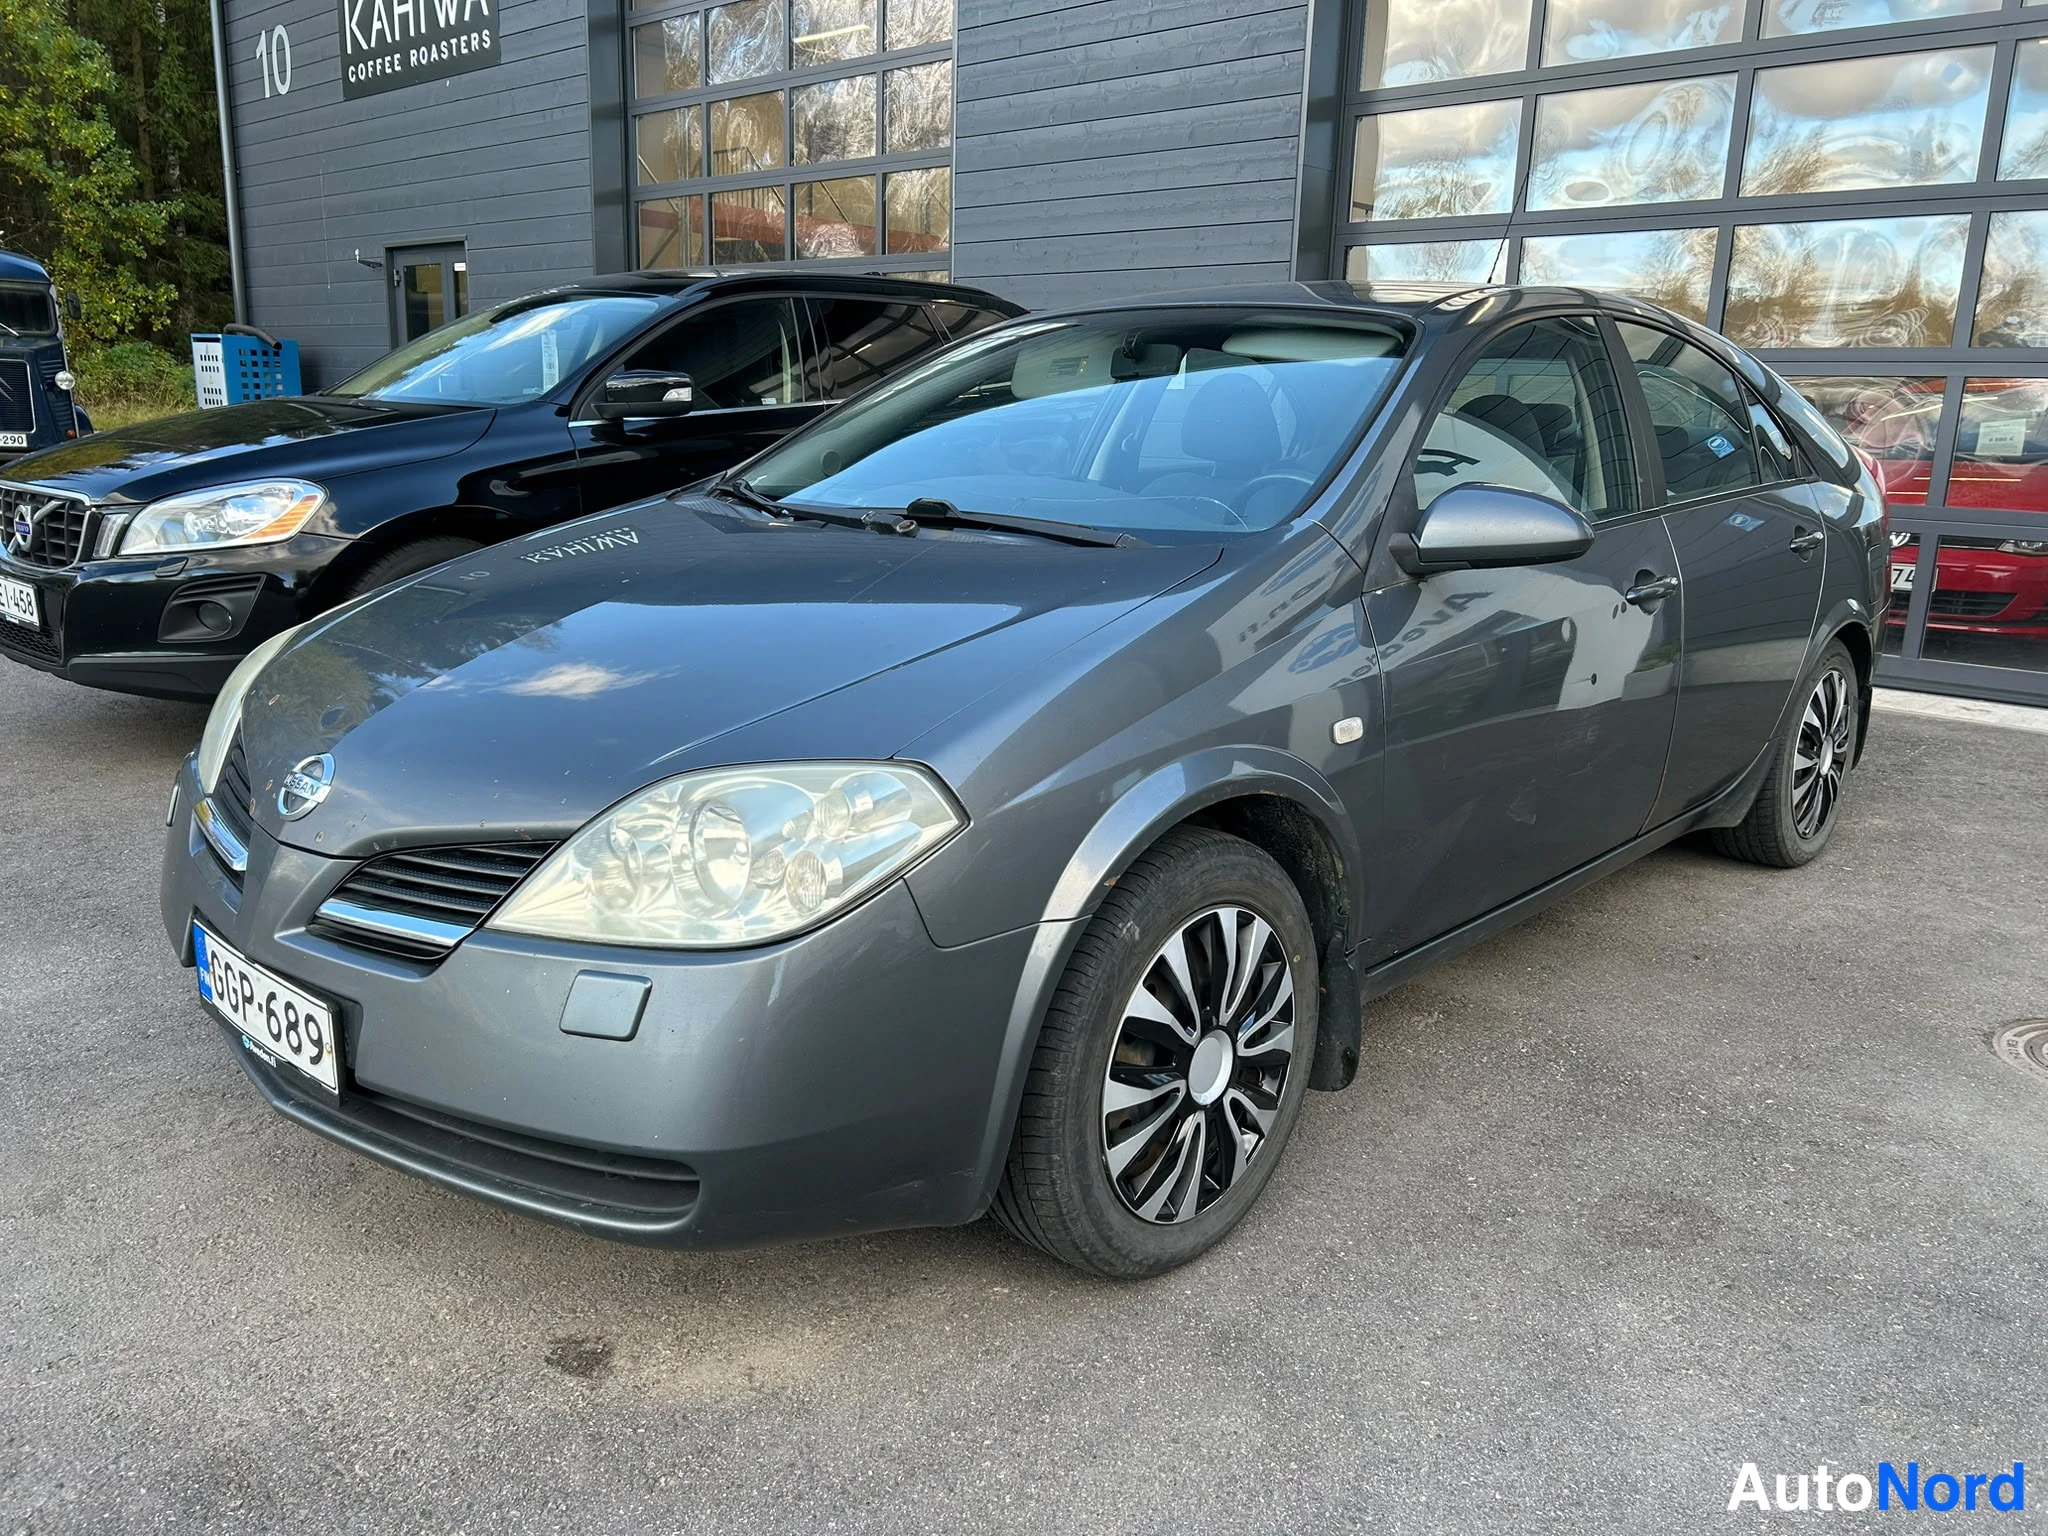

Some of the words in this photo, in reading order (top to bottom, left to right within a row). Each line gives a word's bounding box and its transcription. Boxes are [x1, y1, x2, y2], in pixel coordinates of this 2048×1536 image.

[256, 24, 292, 98] 10
[348, 54, 402, 83] COFFEE
[410, 29, 492, 68] ROASTERS
[210, 950, 324, 1066] GGP-689
